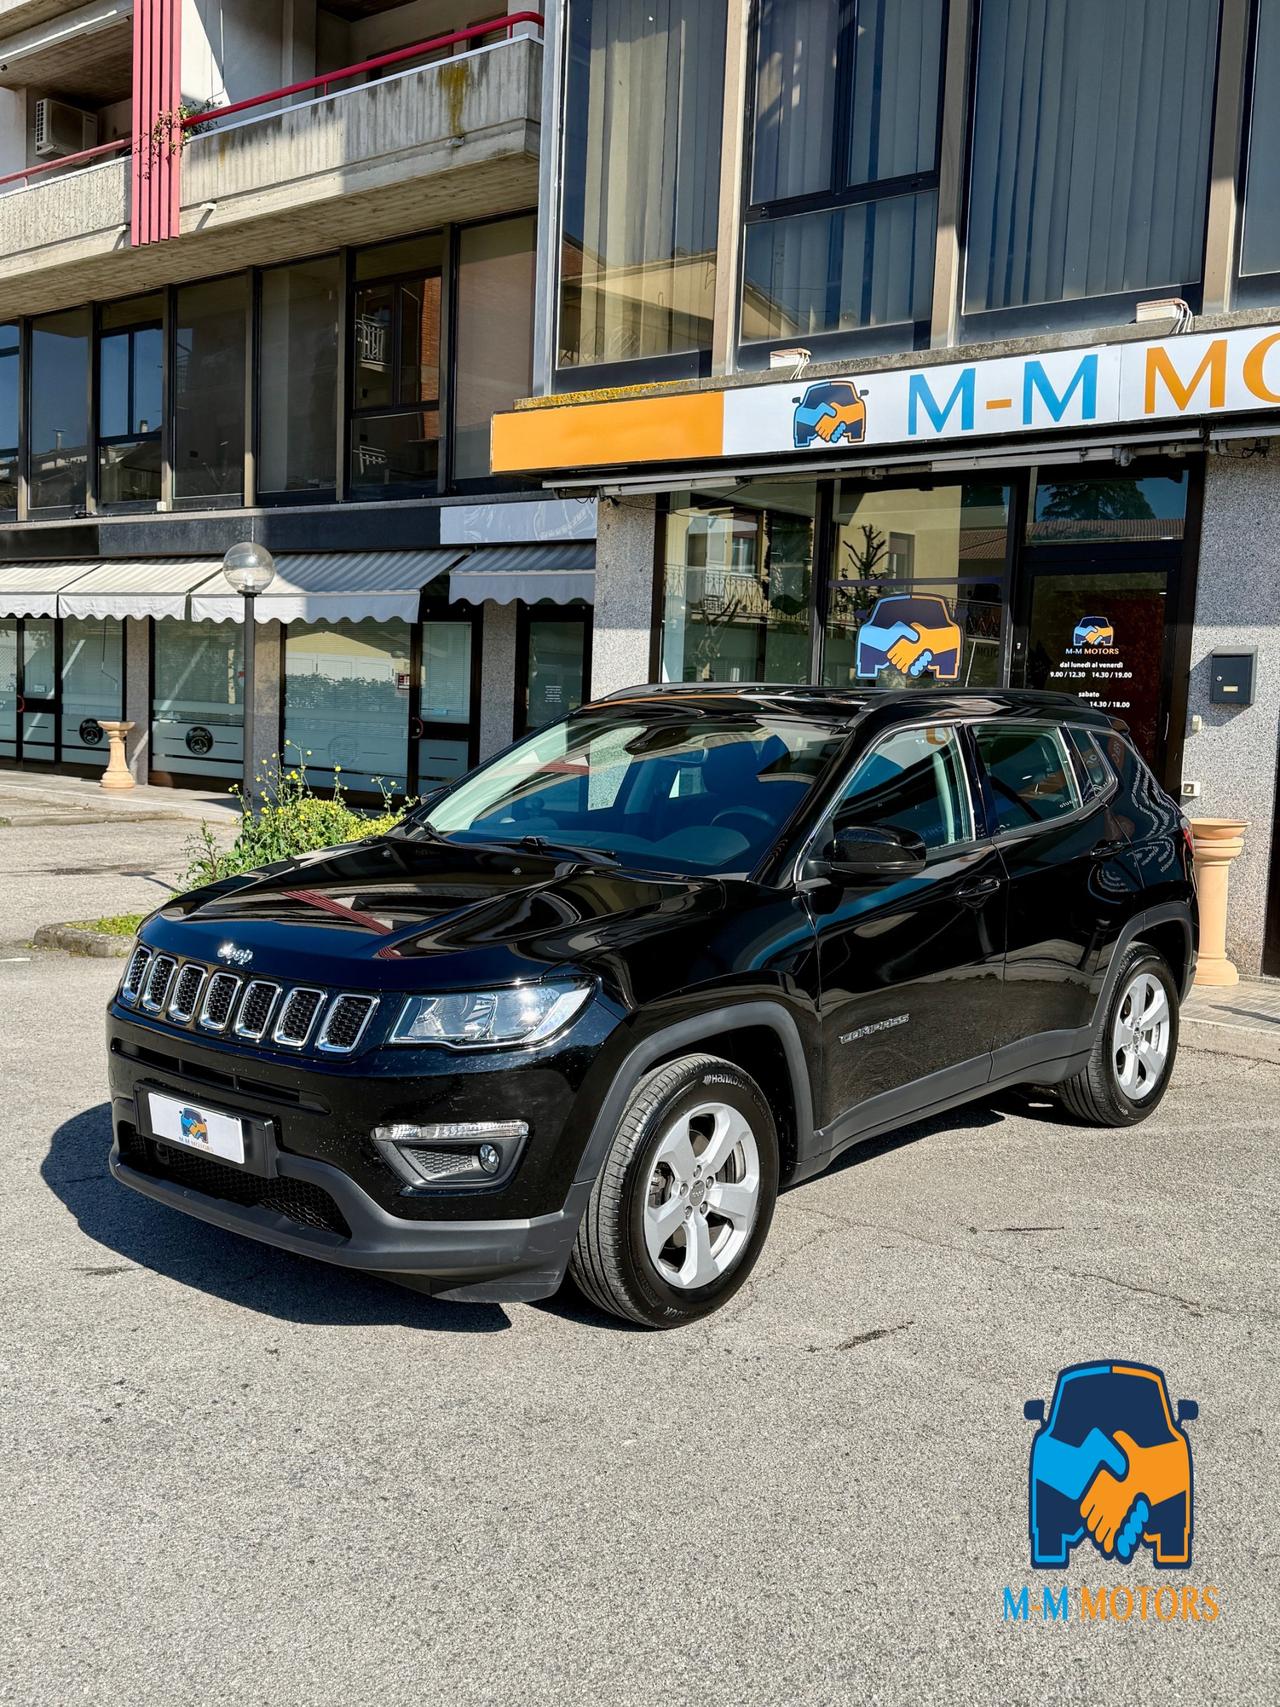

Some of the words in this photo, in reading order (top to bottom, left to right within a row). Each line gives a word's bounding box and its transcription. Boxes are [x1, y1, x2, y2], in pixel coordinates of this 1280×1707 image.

[908, 355, 1097, 435] M-M
[1065, 647, 1083, 655] M-M
[1084, 647, 1120, 655] MOTORS
[1114, 671, 1133, 679] 19.00
[217, 943, 253, 964] Jeep
